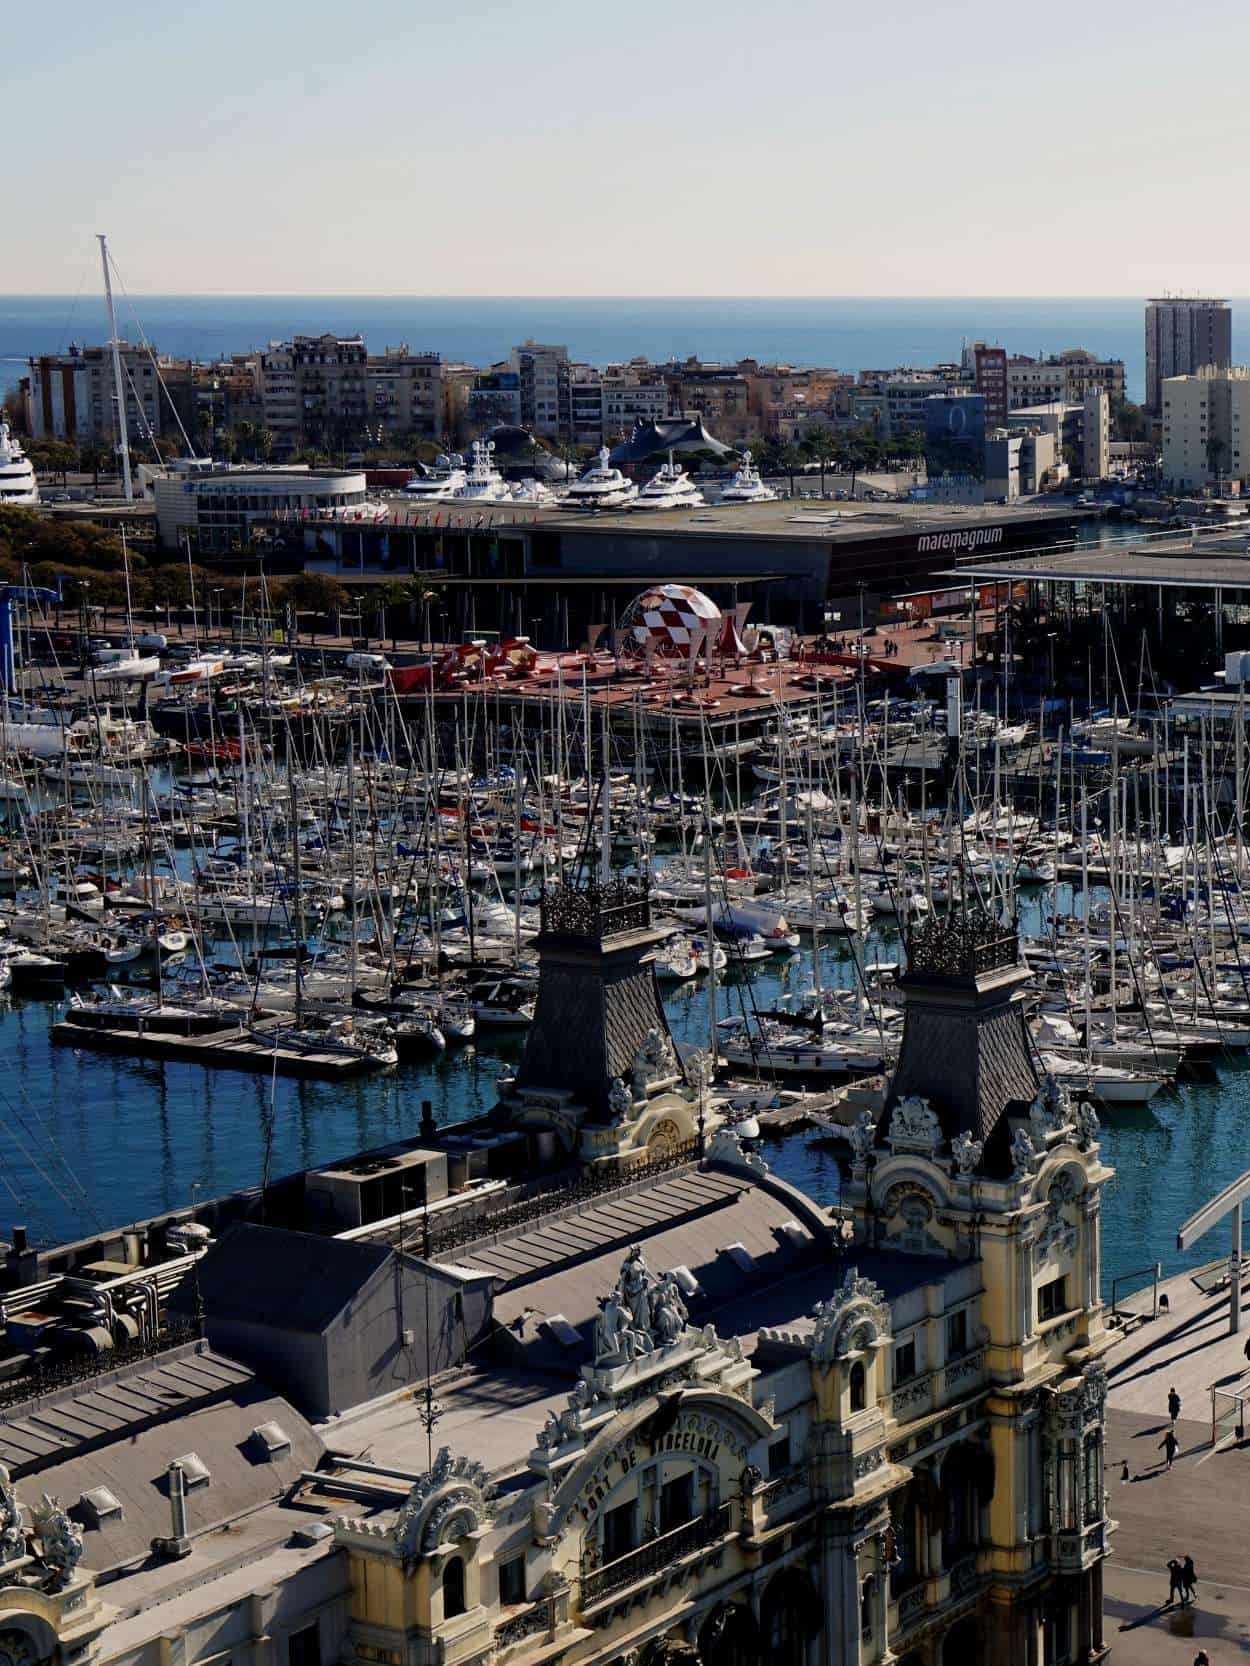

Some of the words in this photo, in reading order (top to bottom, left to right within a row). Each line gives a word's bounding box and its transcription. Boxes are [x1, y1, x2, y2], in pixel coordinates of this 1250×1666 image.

[917, 527, 1003, 551] maremagnum
[581, 1475, 611, 1521] PORT
[621, 1450, 637, 1473] DE
